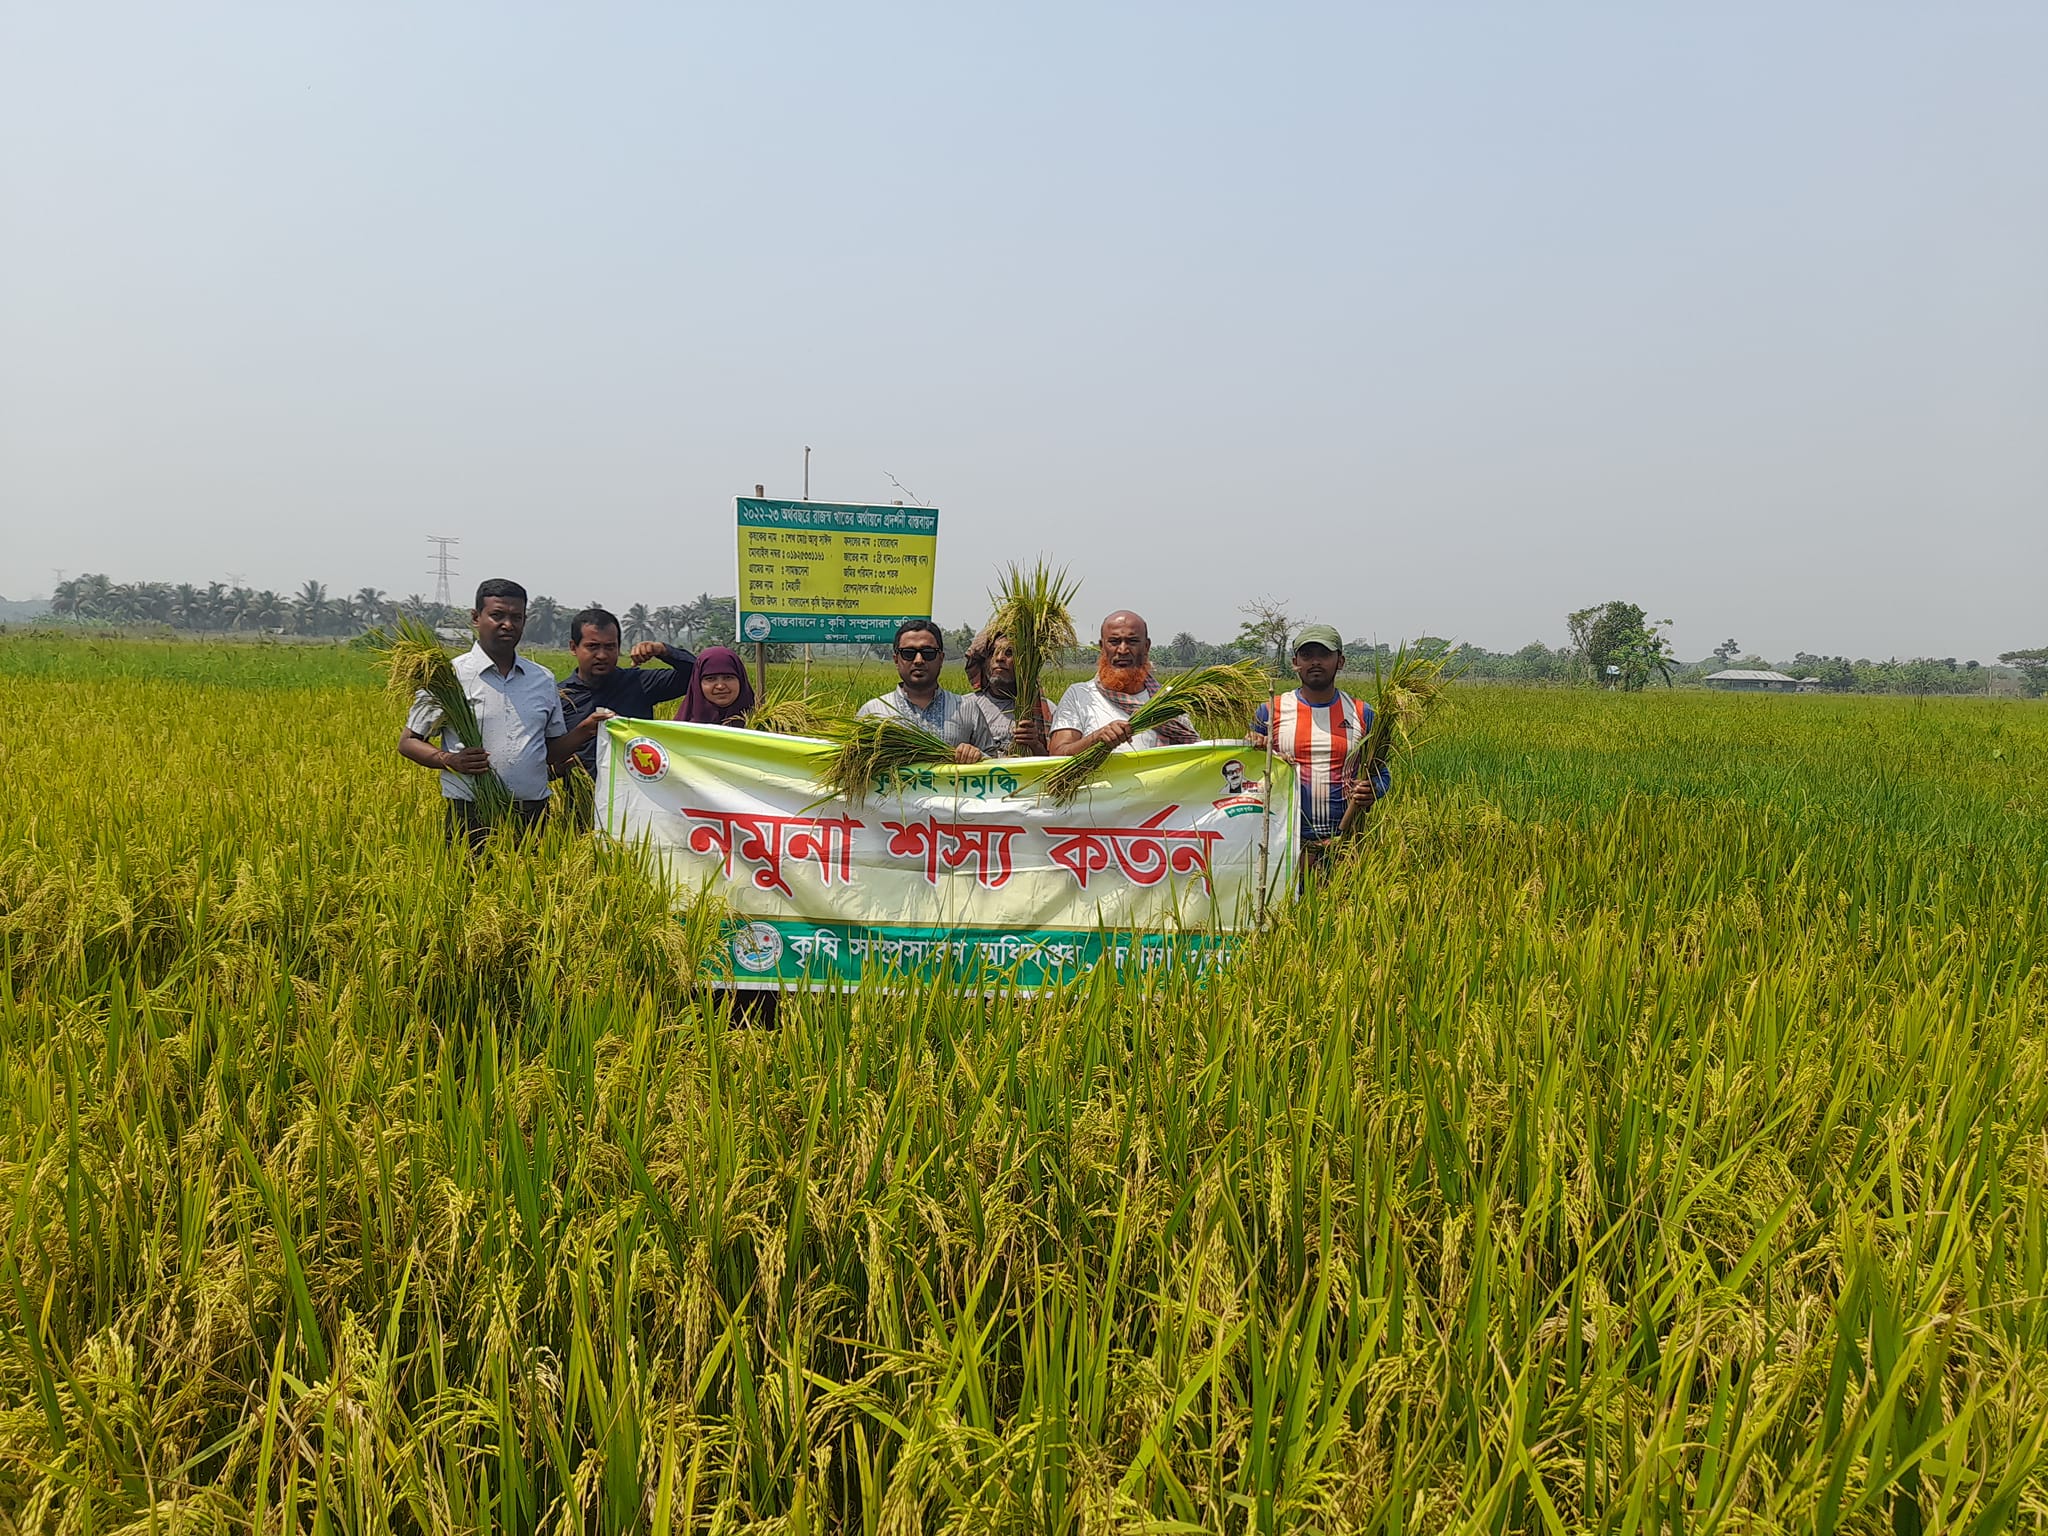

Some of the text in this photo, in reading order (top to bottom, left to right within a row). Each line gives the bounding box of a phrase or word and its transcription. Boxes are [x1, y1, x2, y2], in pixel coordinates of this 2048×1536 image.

[743, 506, 779, 524] ২০২২-২৩
[828, 615, 846, 632] কৃষি
[680, 804, 1225, 899] নমুনা শস্য কর্তন
[787, 928, 842, 969] কৃষি
